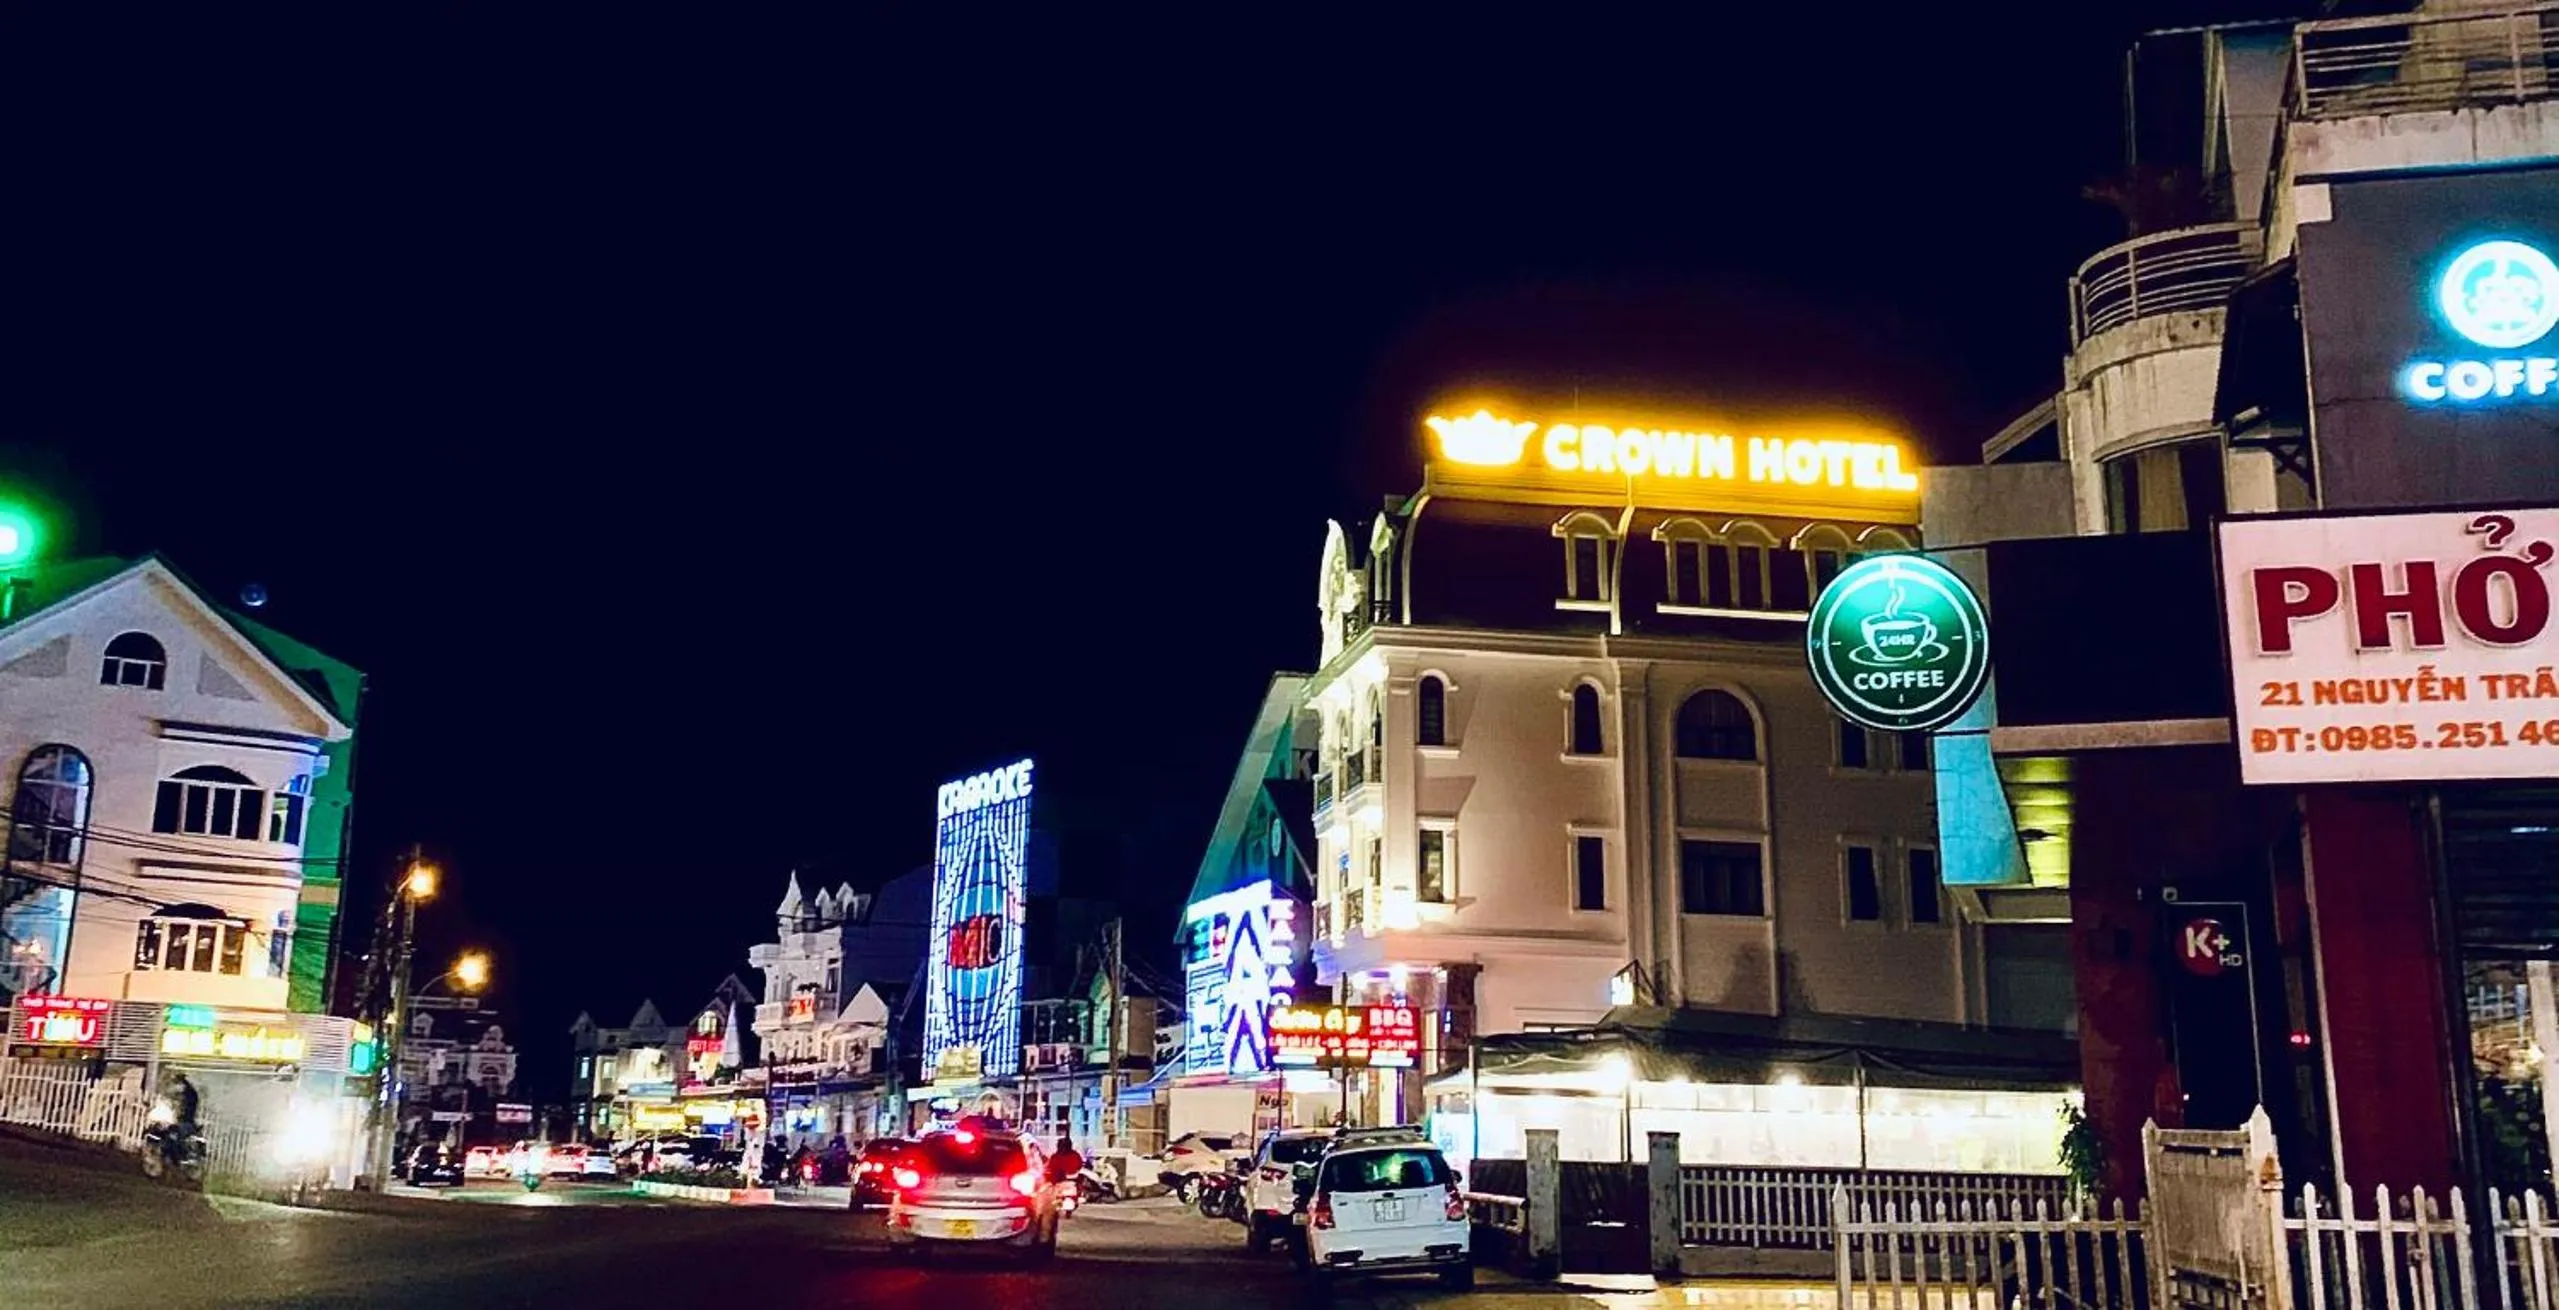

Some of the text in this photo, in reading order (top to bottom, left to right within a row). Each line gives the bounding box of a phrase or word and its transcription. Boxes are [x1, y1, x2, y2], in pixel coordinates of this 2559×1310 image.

[1543, 423, 1918, 491] CROWN HOTEL
[2252, 514, 2555, 654] PHỞ
[1853, 669, 1946, 691] COFFEE
[2260, 681, 2304, 707] 21
[2312, 665, 2467, 706] NGUYỄN
[938, 758, 1034, 820] KARAOKE
[2219, 954, 2243, 967] HD
[1369, 1007, 1414, 1028] BBQ
